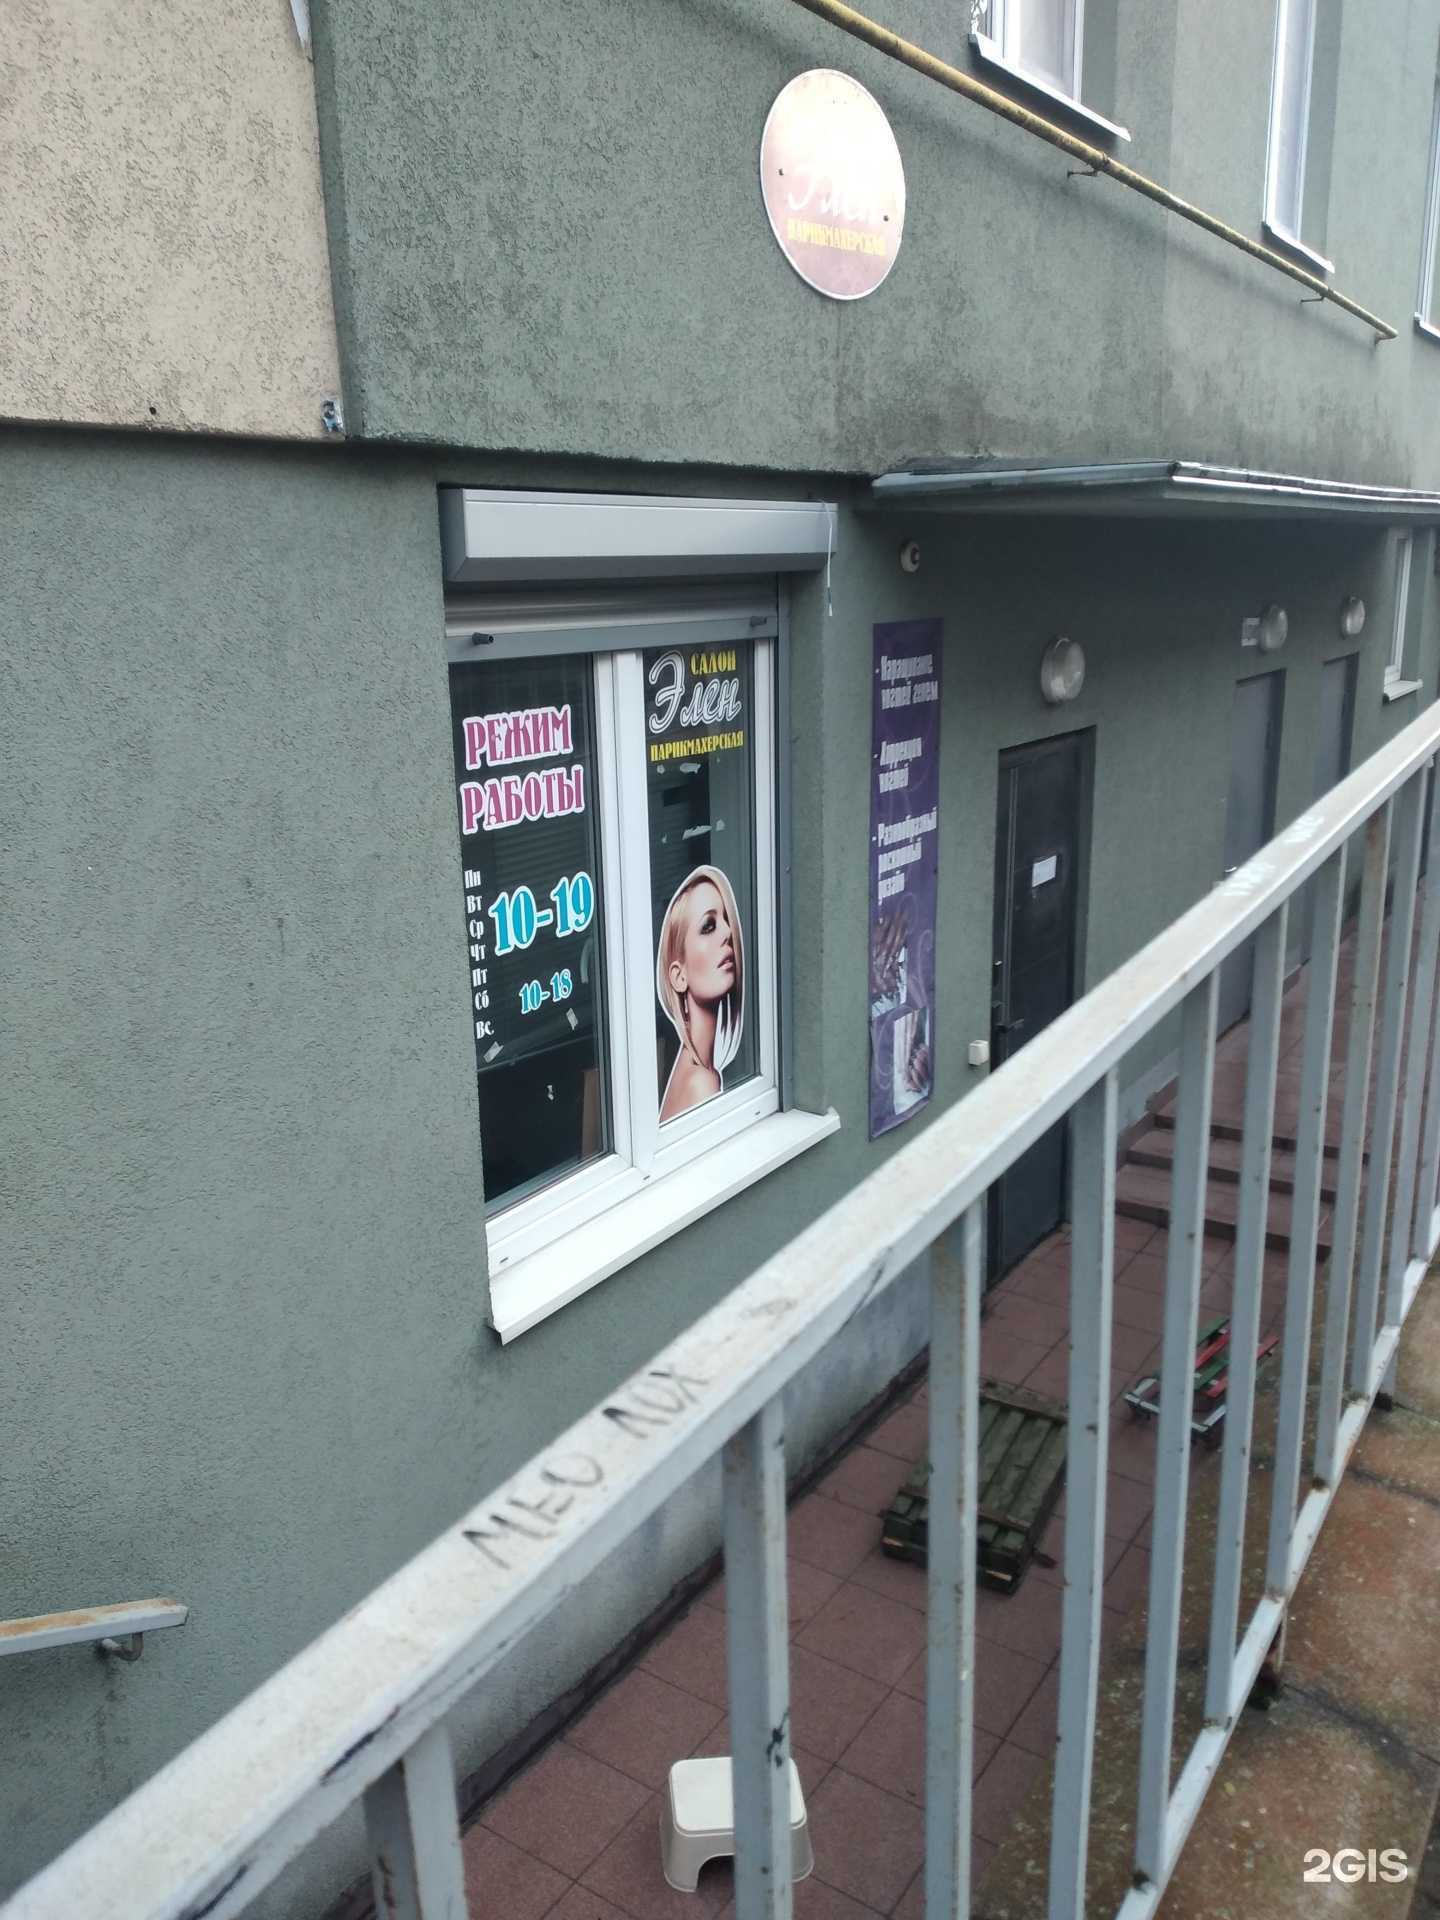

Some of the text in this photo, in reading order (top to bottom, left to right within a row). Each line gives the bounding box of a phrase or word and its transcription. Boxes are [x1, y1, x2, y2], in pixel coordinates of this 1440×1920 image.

[690, 650, 736, 675] САЛОН
[648, 650, 742, 733] Элен
[463, 704, 573, 770] РЕЖИМ
[650, 731, 744, 762] ПАРИКМАХЕРСКАЯ
[460, 764, 585, 835] РАБОТЫ
[464, 869, 482, 889] Пн
[466, 895, 483, 914] Вт
[488, 871, 595, 957] 10-19
[469, 919, 485, 940] Ср
[470, 943, 487, 962] Чт
[472, 968, 488, 987] Пт
[475, 990, 490, 1011] Сб
[518, 968, 573, 1015] 10-18
[476, 1020, 495, 1040] Вс
